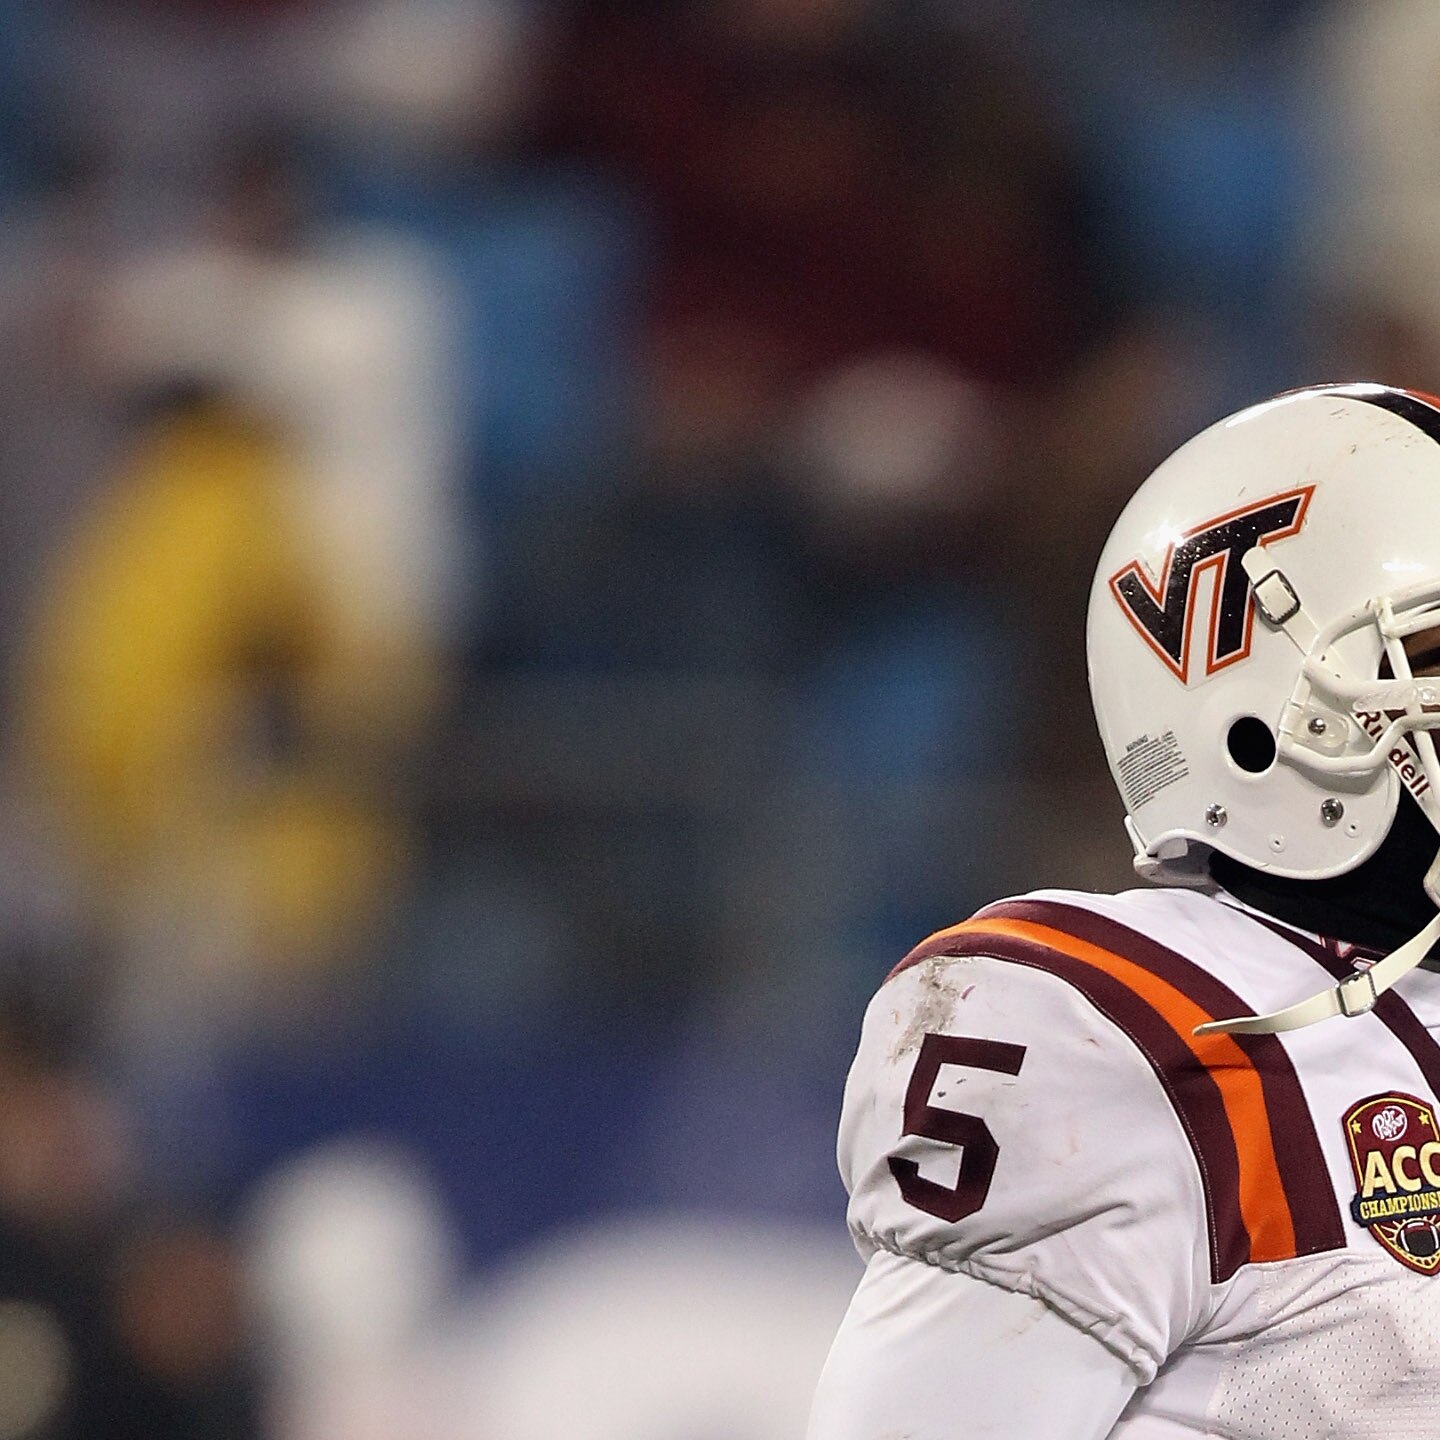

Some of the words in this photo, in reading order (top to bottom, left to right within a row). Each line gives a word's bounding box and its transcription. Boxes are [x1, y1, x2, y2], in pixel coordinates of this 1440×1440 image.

[1109, 485, 1316, 685] VT
[1355, 711, 1430, 797] Ridell
[888, 1033, 1027, 1223] 5
